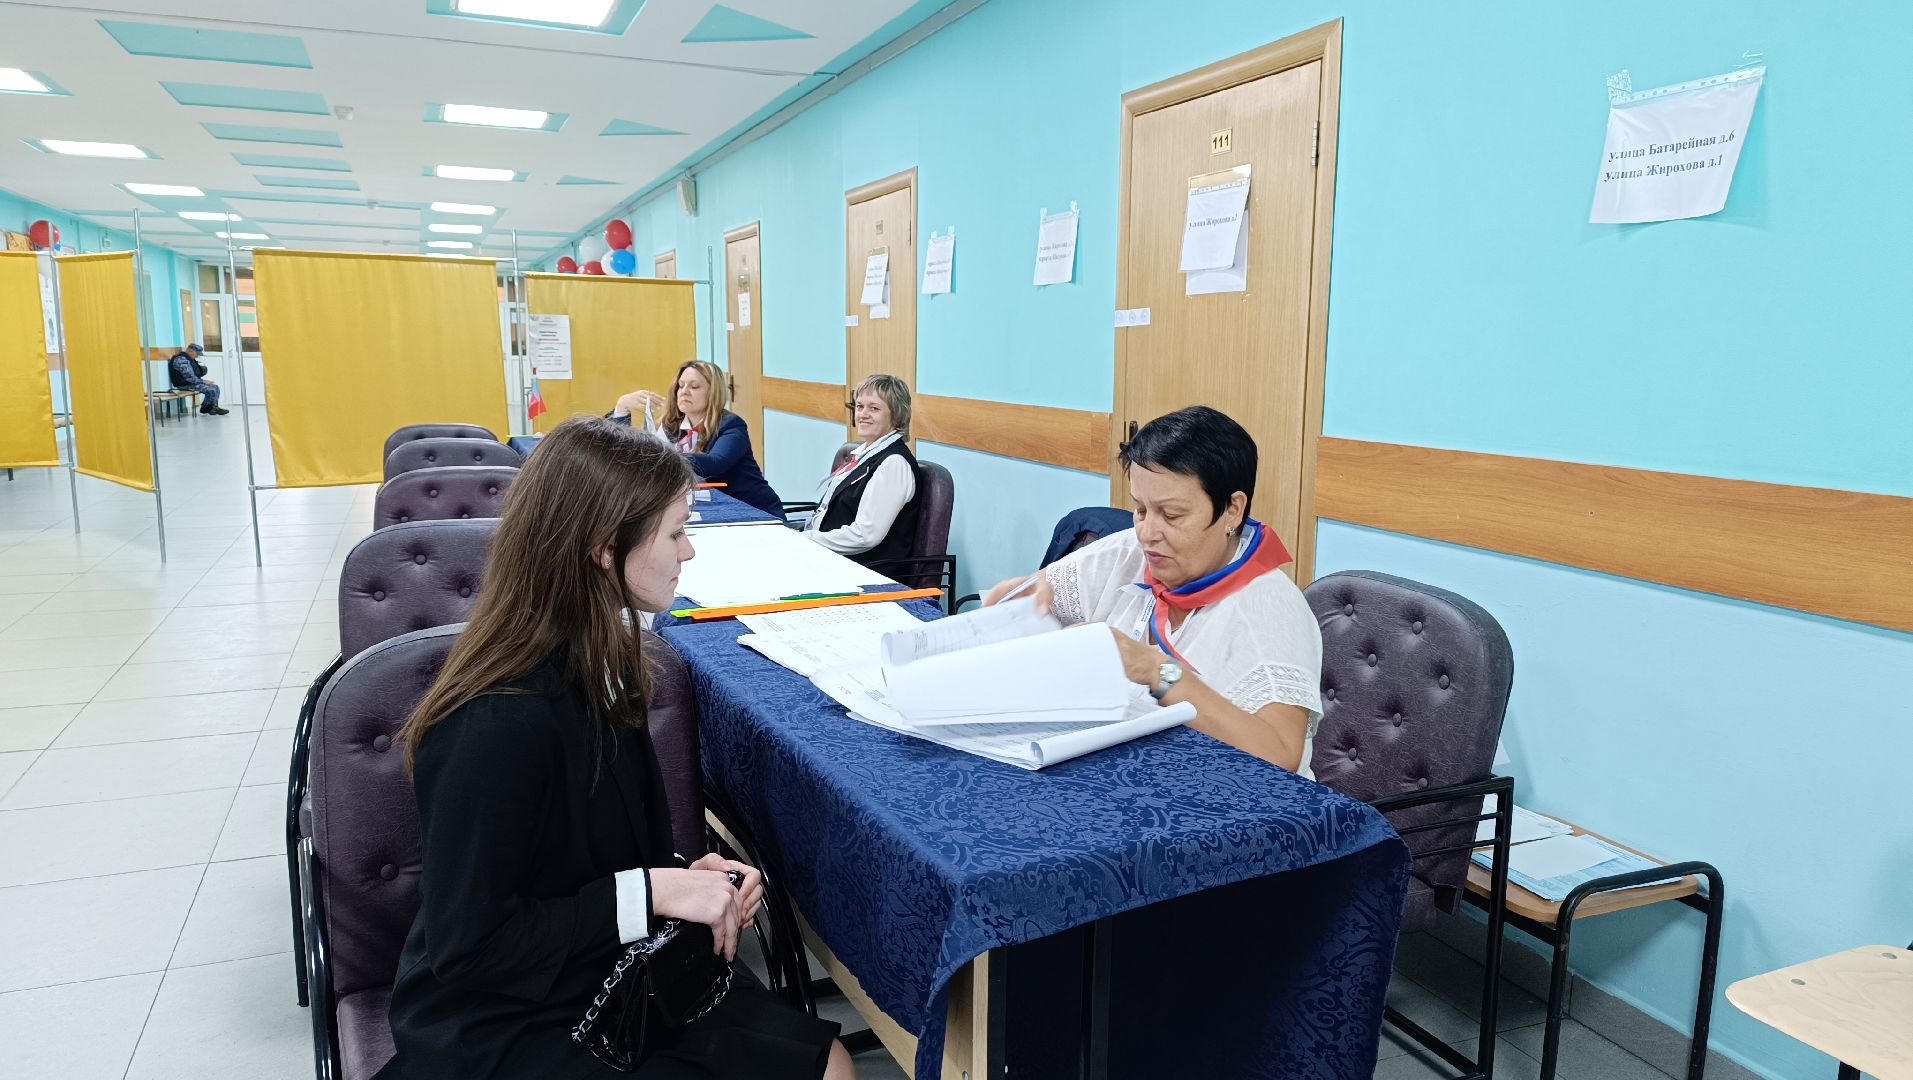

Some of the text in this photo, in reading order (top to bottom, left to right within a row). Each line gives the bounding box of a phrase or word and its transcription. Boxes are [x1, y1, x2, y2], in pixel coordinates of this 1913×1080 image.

[1212, 134, 1229, 149] 111
[1608, 129, 1735, 162] улица Батарейная д.6
[1604, 154, 1723, 182] улица Жирохова д.1
